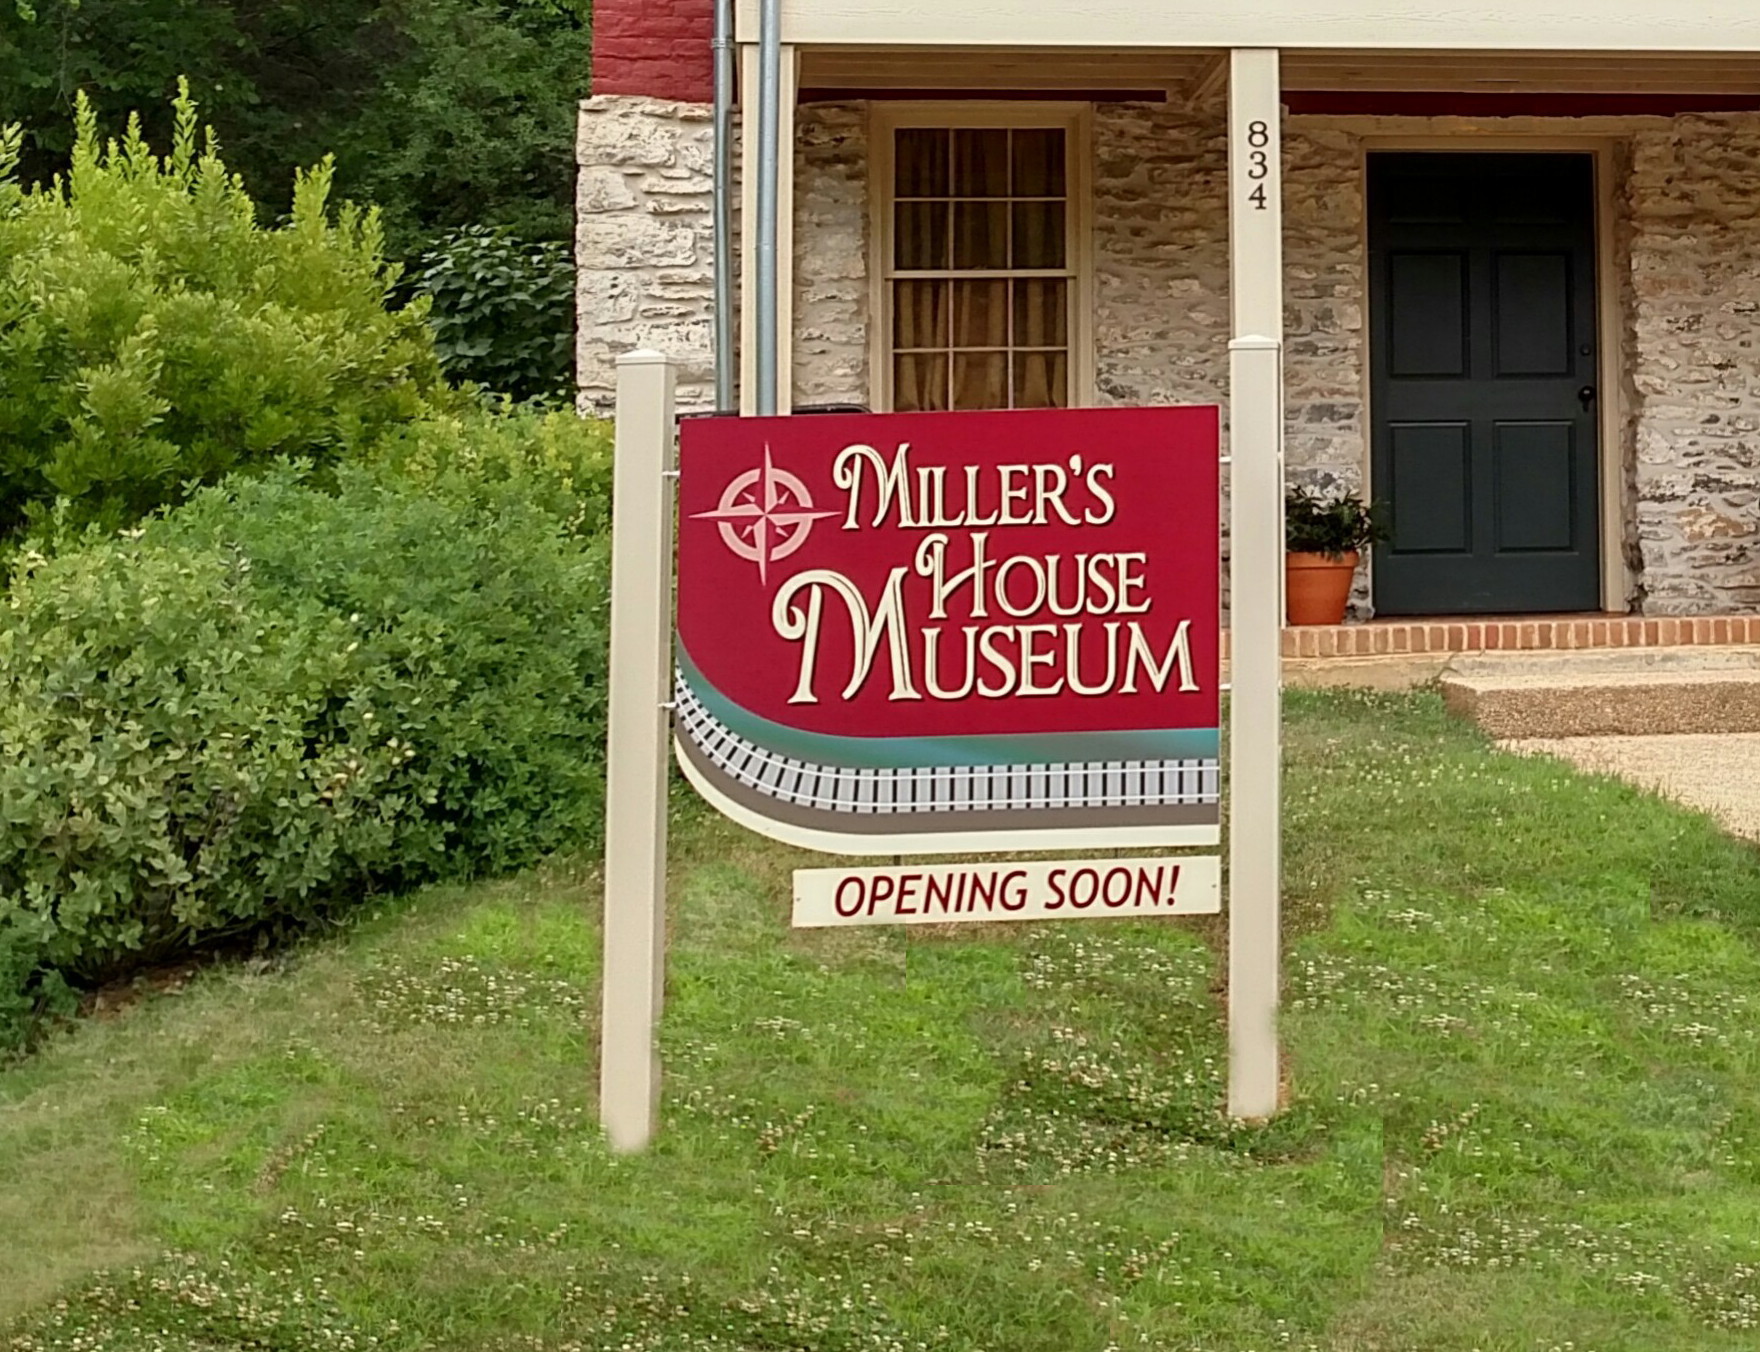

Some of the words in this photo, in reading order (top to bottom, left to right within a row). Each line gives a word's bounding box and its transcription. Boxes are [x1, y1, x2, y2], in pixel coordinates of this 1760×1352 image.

[1247, 120, 1269, 210] 834
[833, 443, 1116, 529] MILLER'S
[915, 532, 1151, 618] HOUSE
[772, 567, 1200, 704] MUSEUM
[833, 871, 1028, 917] OPENING
[1043, 865, 1181, 911] SOON!
